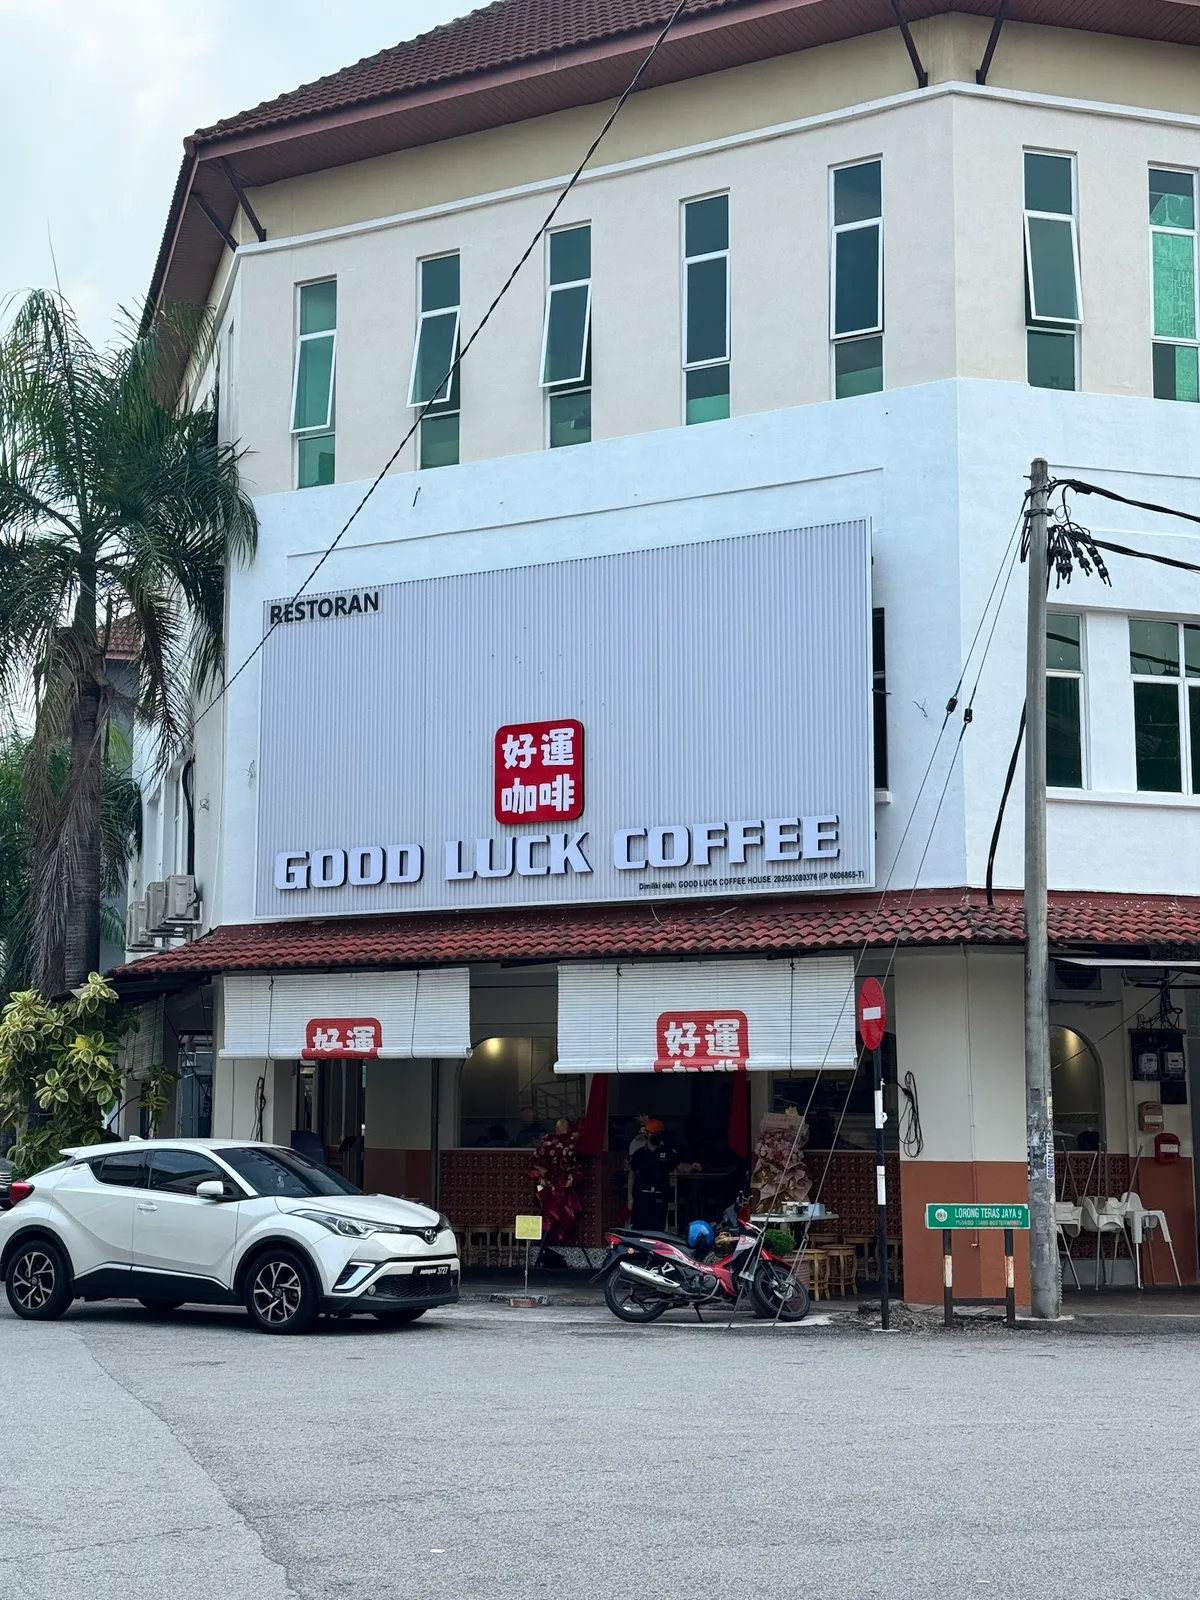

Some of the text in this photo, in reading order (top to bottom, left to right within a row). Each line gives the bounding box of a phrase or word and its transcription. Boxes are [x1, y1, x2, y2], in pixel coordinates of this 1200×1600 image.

[269, 591, 379, 625] RESTORAN
[501, 726, 575, 770] 好運
[500, 773, 575, 815] 咖啡
[274, 814, 841, 890] GOOD LUCK COFFEE
[661, 881, 677, 890] oleh:
[678, 880, 699, 889] GOOD
[699, 878, 718, 887] LUCK
[719, 876, 746, 886] COFFEE
[747, 875, 772, 884] HOUSE
[312, 1026, 375, 1052] 好運
[664, 1018, 741, 1058] 好運
[954, 1207, 1023, 1219] LORONG TERAS JAYA 9
